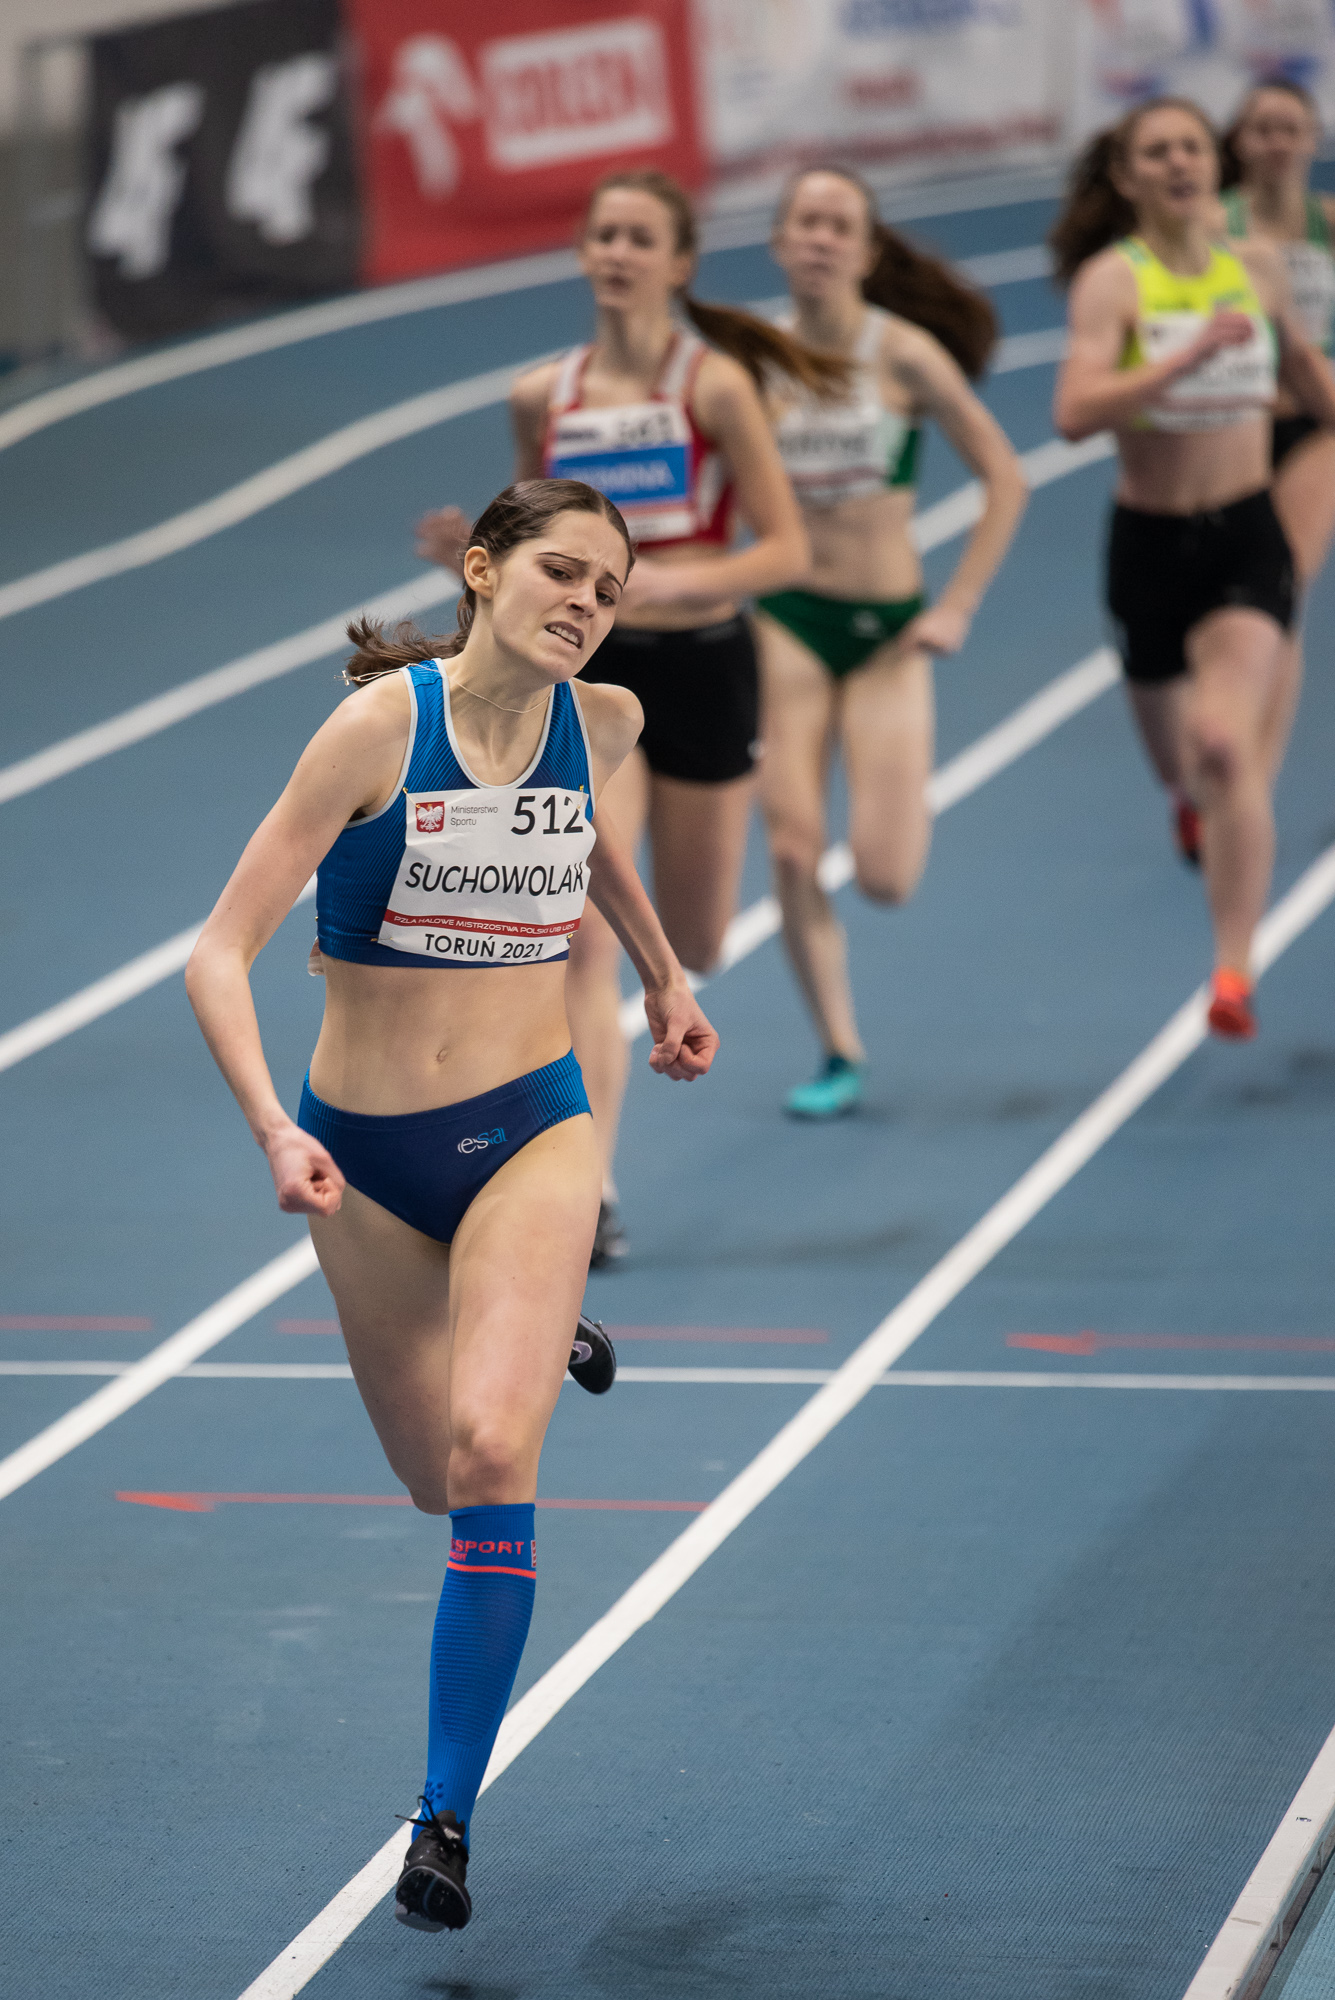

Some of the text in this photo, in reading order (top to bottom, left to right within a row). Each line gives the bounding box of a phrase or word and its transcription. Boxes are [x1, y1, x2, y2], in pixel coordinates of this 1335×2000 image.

[450, 805, 499, 815] Ministerstwo
[510, 794, 584, 836] 512
[450, 818, 477, 827] Sportu
[404, 861, 584, 897] SUCHOWOLAK
[393, 915, 417, 924] PZLA
[418, 918, 455, 926] HALOWE
[455, 920, 519, 933] MISTRZOSTWA
[425, 933, 544, 958] TORUŃ 2021
